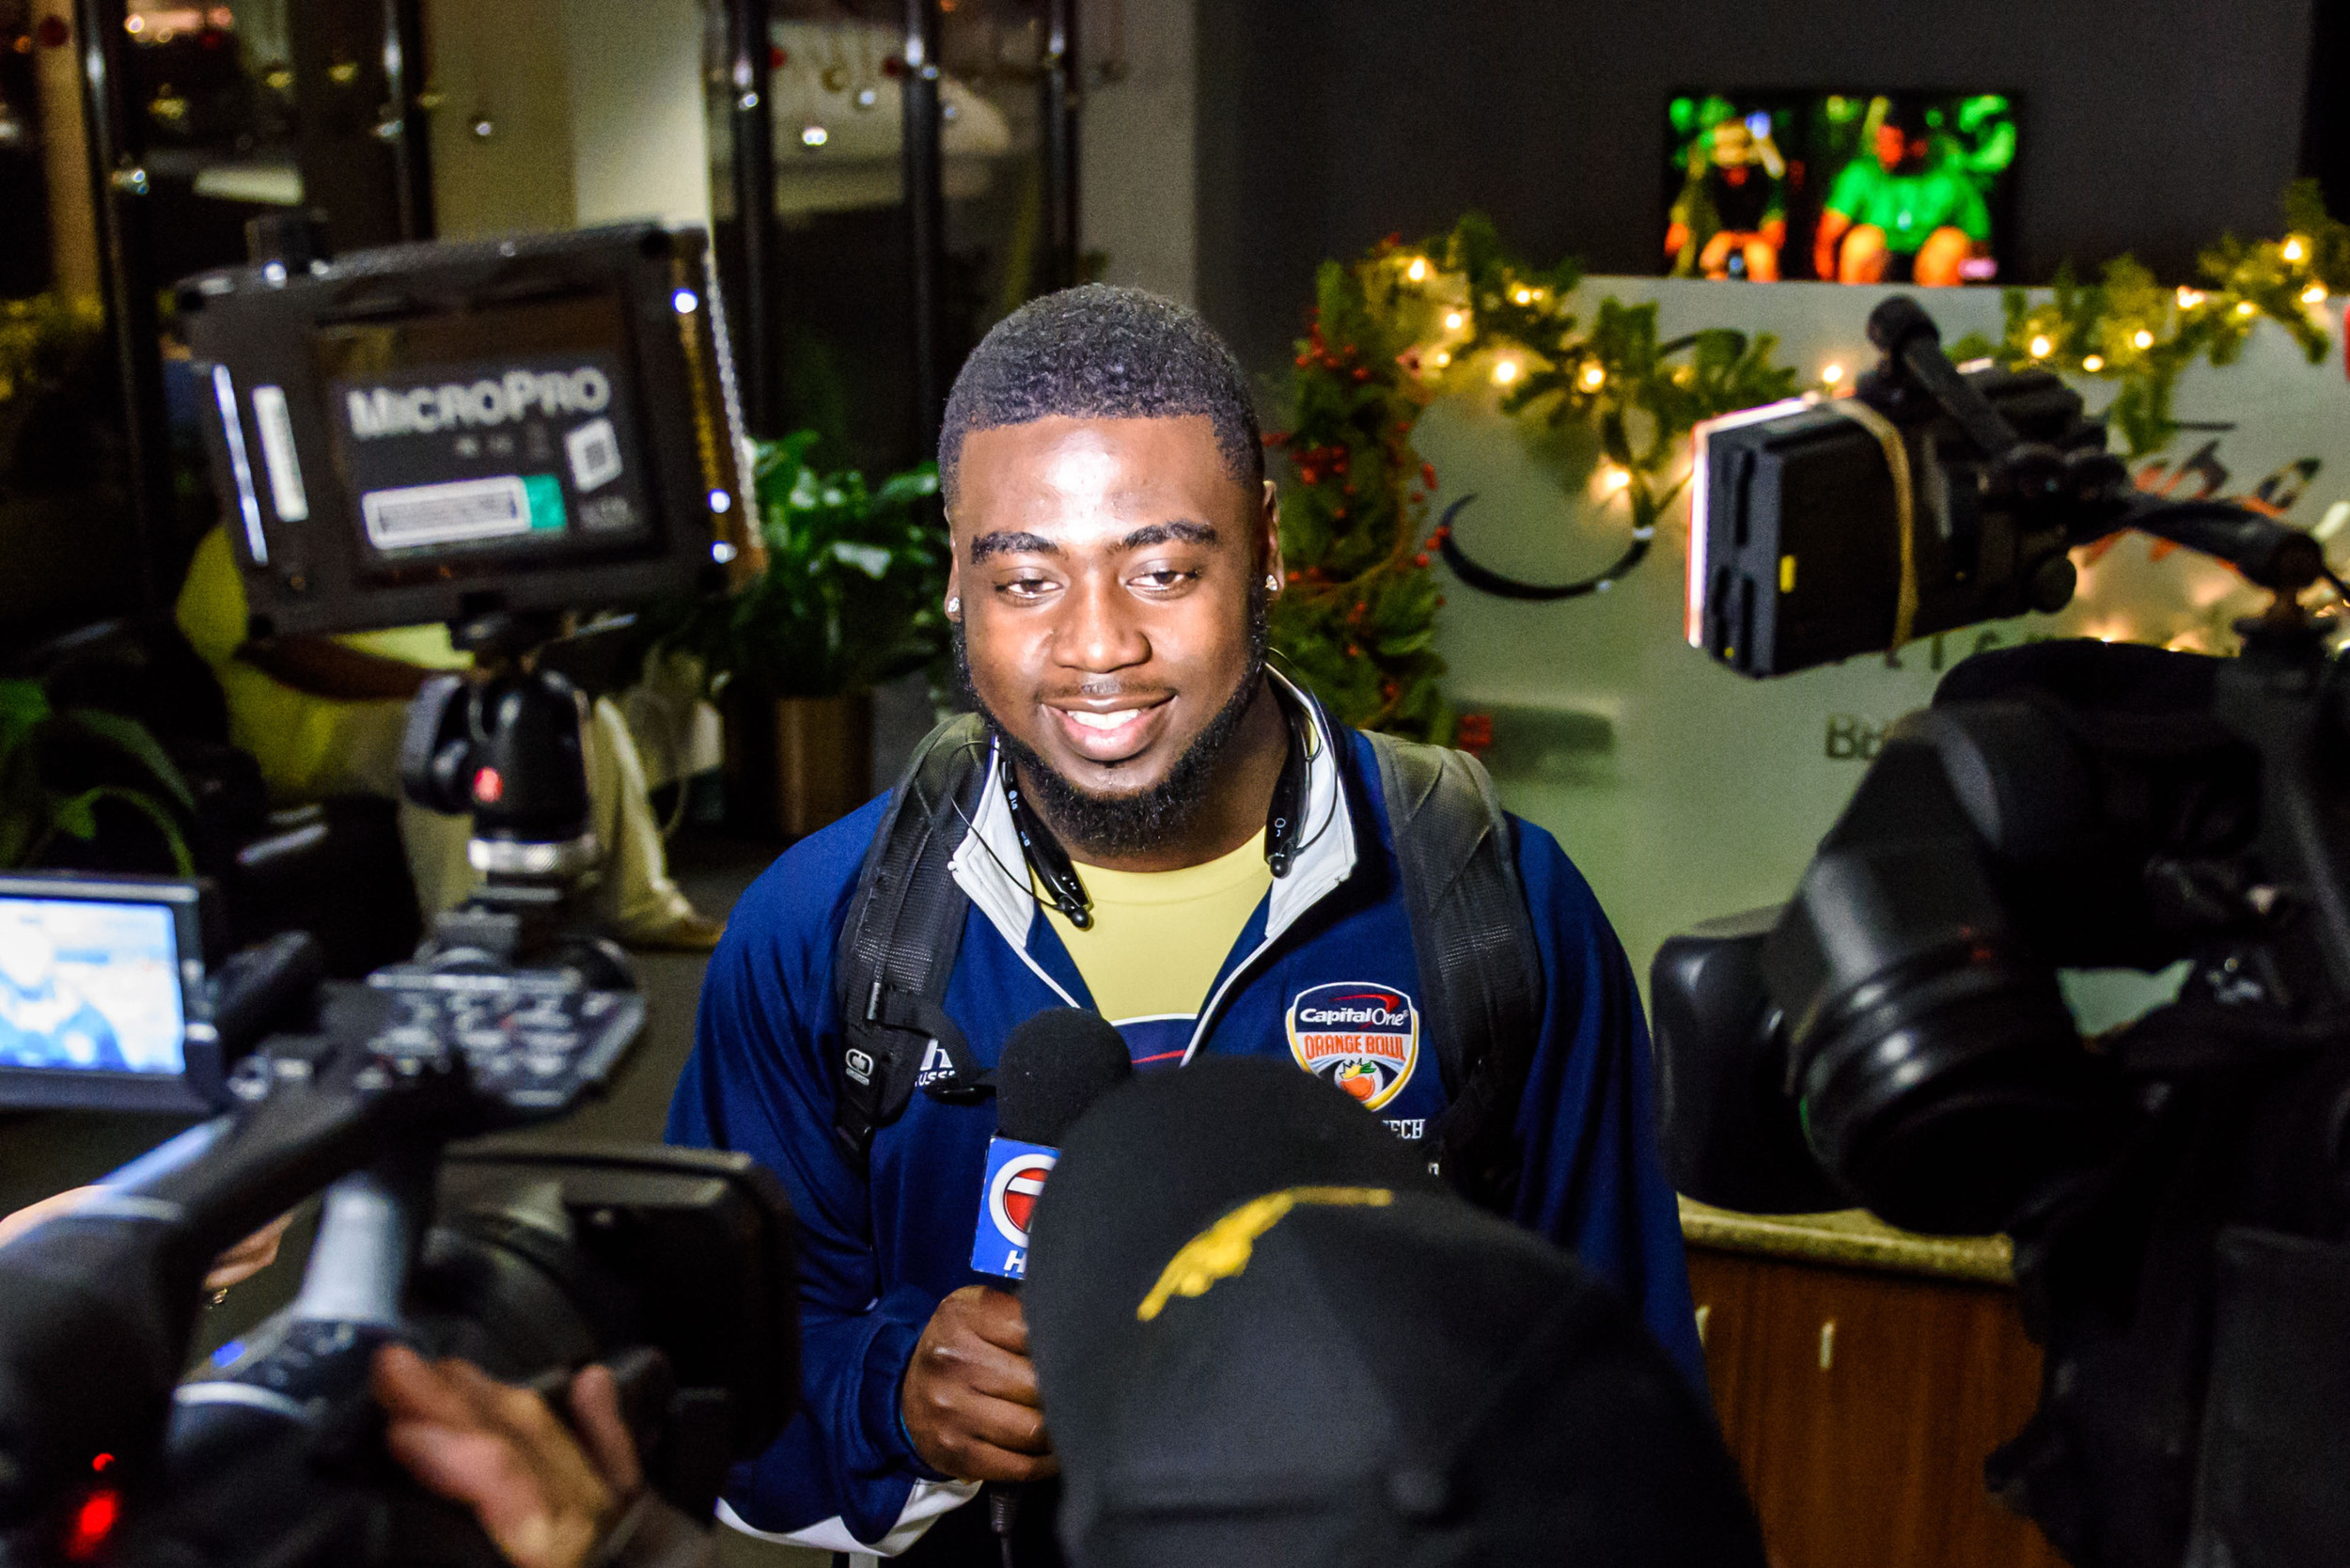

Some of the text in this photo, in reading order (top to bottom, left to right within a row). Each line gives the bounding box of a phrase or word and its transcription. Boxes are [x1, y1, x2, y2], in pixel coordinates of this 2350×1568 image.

[1305, 1034, 1406, 1062] ORANGE BOWL
[915, 1070, 956, 1087] USS
[1383, 1119, 1426, 1139] ECH
